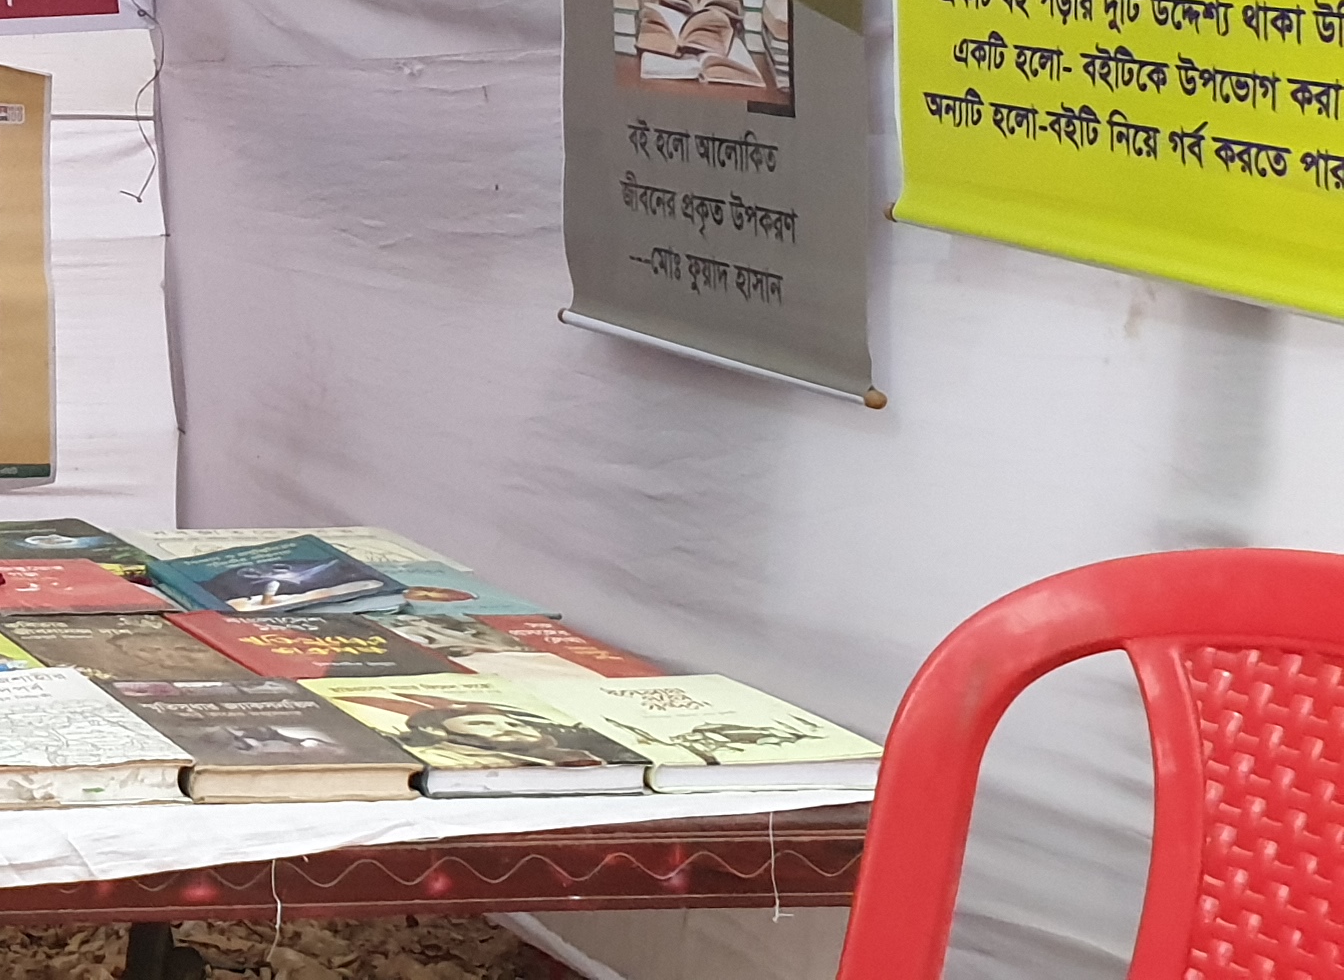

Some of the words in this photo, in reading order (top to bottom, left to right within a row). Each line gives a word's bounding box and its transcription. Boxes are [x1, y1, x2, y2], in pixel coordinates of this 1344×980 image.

[953, 30, 1008, 70] একটি
[1080, 43, 1169, 93] বইটিকে
[1175, 52, 1281, 111] উপভোগ
[628, 117, 651, 159] বই
[654, 126, 691, 163] হলো
[695, 130, 778, 173] আলোকিত
[923, 87, 984, 128] অন্যটি
[1107, 108, 1160, 159] নিয়ে
[1168, 121, 1209, 168] গর্ব
[1211, 135, 1292, 178] করতে
